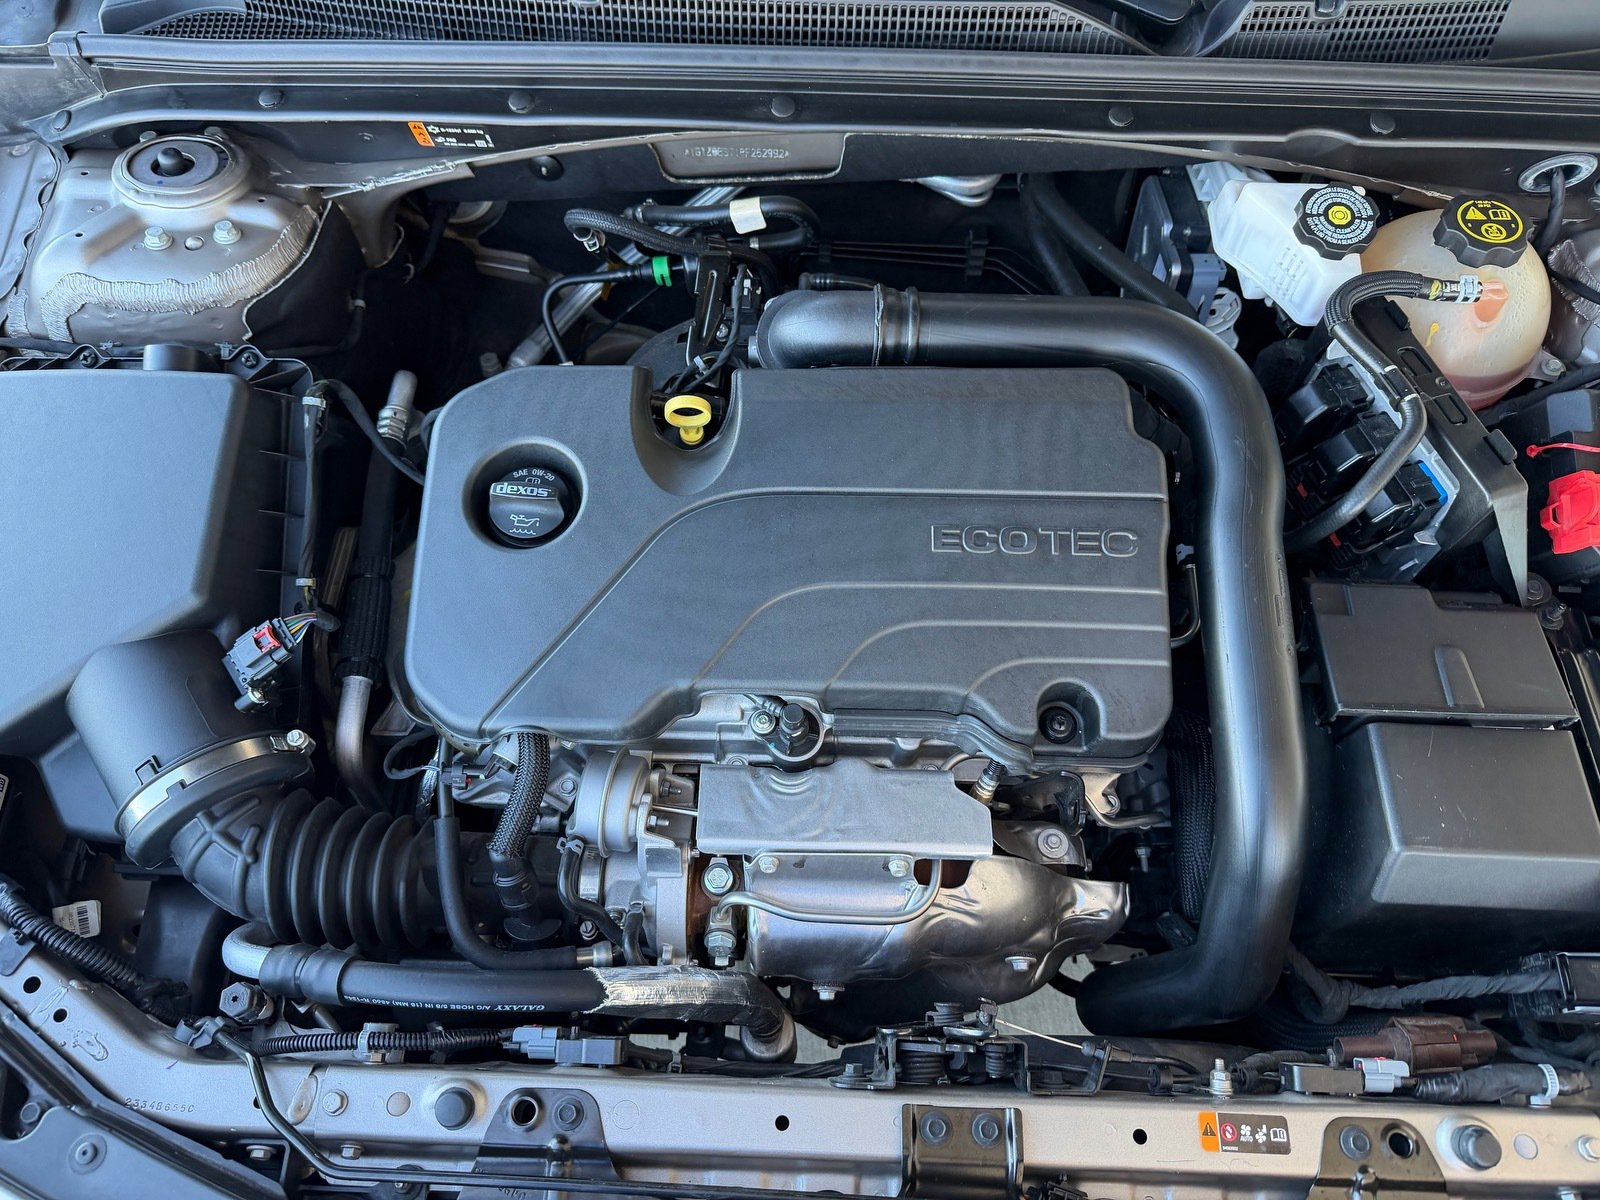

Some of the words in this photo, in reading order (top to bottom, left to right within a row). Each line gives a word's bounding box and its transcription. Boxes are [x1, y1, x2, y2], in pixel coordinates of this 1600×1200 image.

[512, 468, 528, 478] SAE
[532, 468, 555, 481] 0W-20
[496, 482, 551, 497] dexos
[930, 524, 1138, 558] ECOTEC
